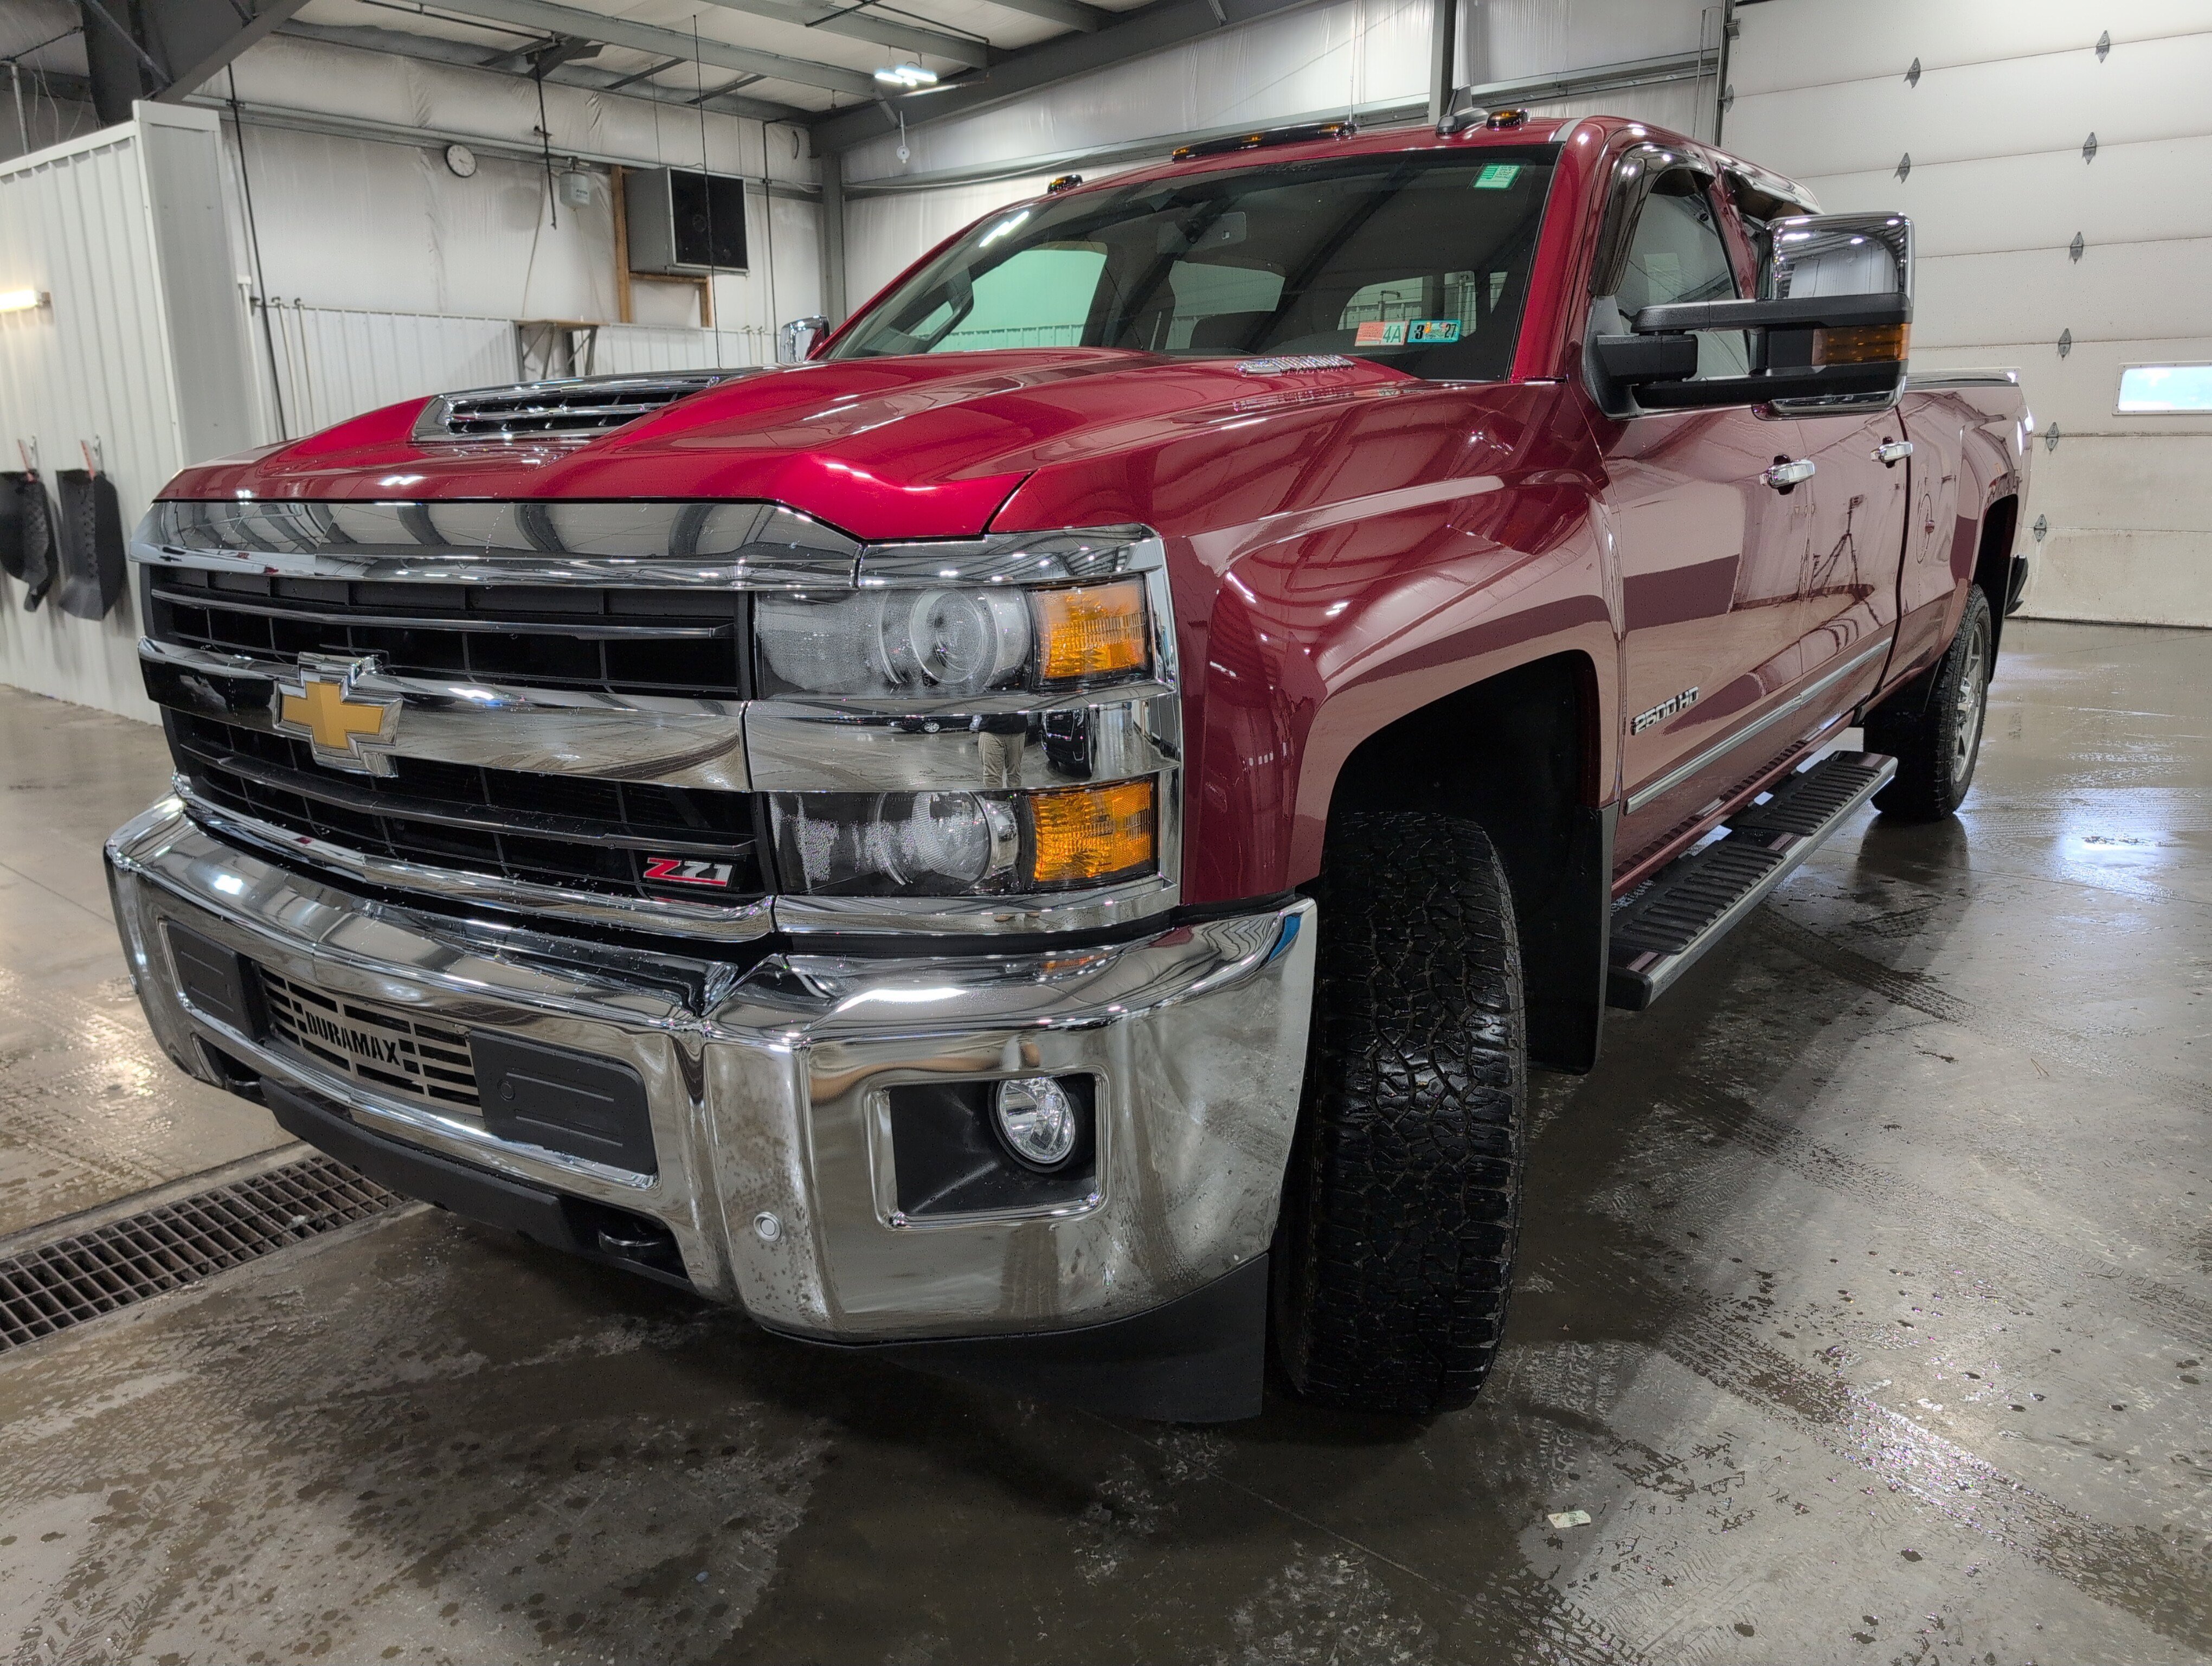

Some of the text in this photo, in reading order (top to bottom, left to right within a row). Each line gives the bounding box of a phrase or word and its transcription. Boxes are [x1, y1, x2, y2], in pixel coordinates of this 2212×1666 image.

[1382, 325, 1401, 343] 4A
[1414, 325, 1424, 339] 3
[1444, 324, 1457, 338] 27
[1630, 686, 1699, 736] 2500HD
[644, 857, 733, 887] Z71
[305, 1011, 401, 1066] DURAMAX
